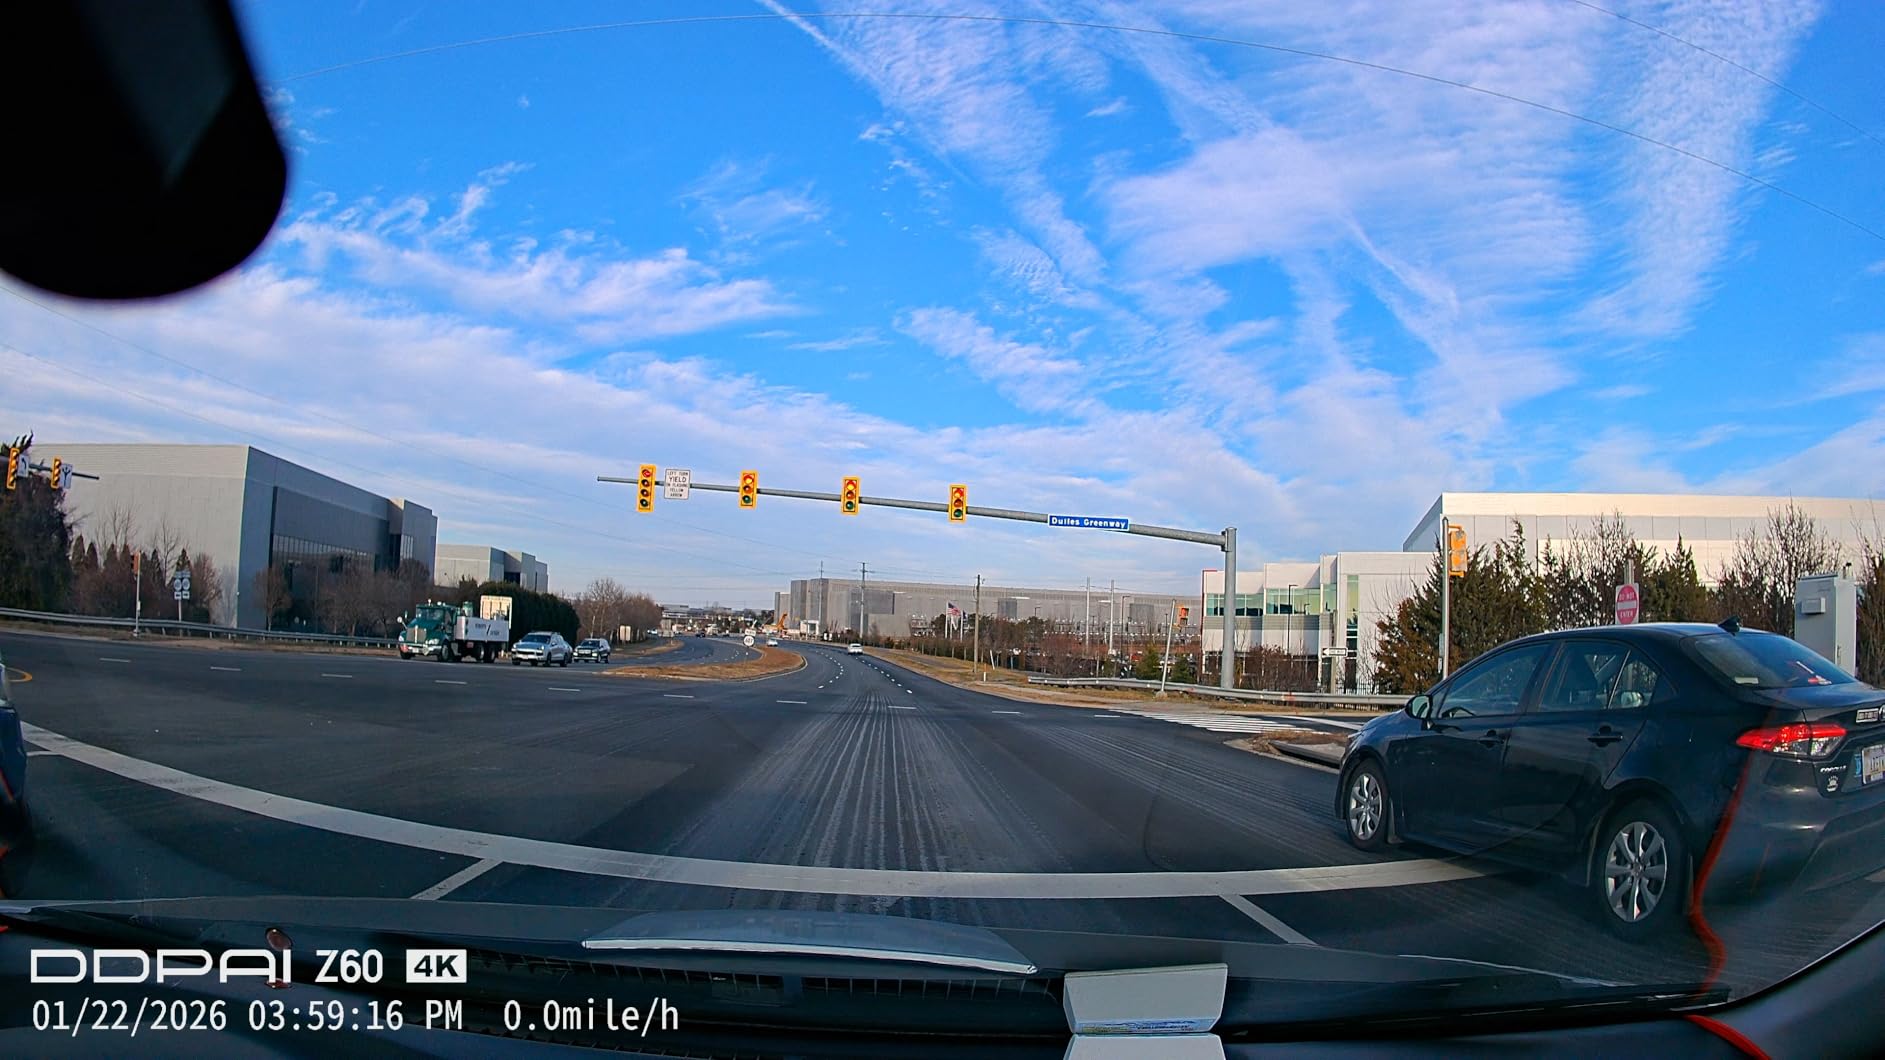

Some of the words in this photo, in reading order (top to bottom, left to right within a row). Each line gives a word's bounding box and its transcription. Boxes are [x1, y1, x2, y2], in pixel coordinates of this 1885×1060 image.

[1051, 516, 1080, 526] Dulles
[1083, 518, 1126, 529] Greenway
[1619, 593, 1625, 601] DO
[1626, 592, 1635, 600] NOT
[1620, 610, 1633, 619] ENTER
